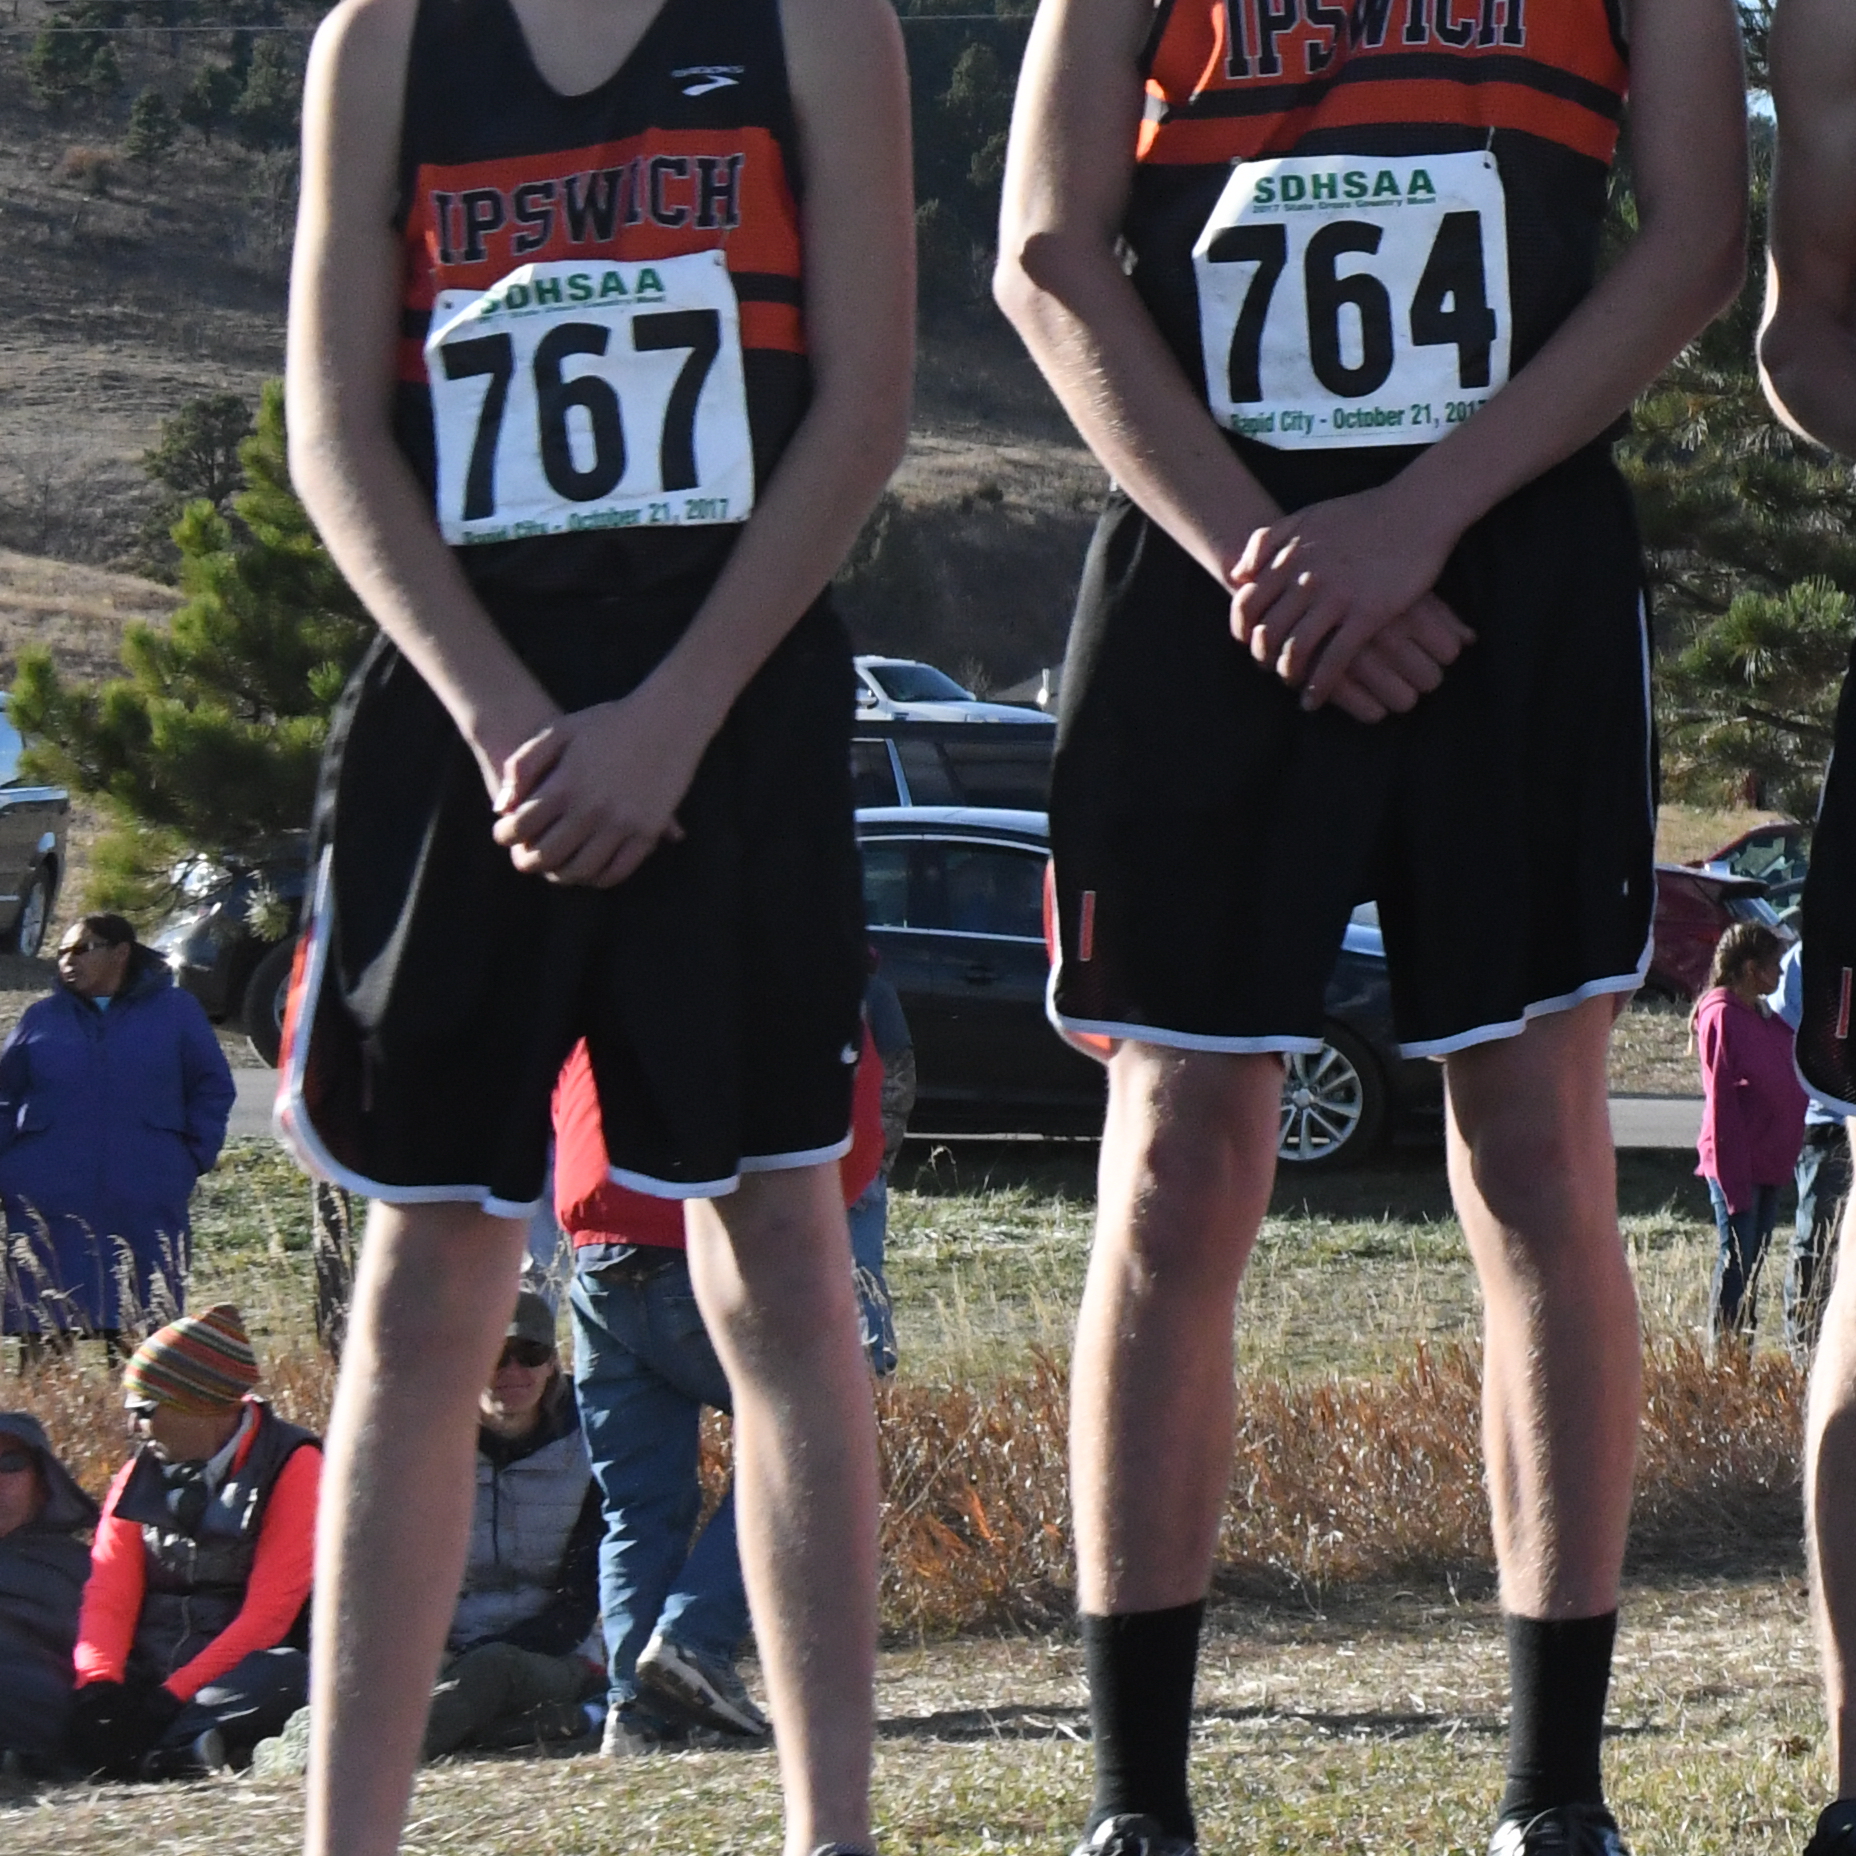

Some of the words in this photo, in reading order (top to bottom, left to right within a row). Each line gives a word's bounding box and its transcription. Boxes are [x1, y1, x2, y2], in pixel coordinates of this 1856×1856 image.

[431, 152, 745, 267] IPSWICH
[1253, 168, 1436, 204] SDHSAA
[481, 267, 665, 315] SDHSAA
[1207, 209, 1497, 404] 764
[441, 308, 721, 522] 767
[1279, 409, 1315, 435] City
[1332, 405, 1405, 430] October
[1410, 403, 1440, 428] 21,
[1444, 399, 1488, 423] 201
